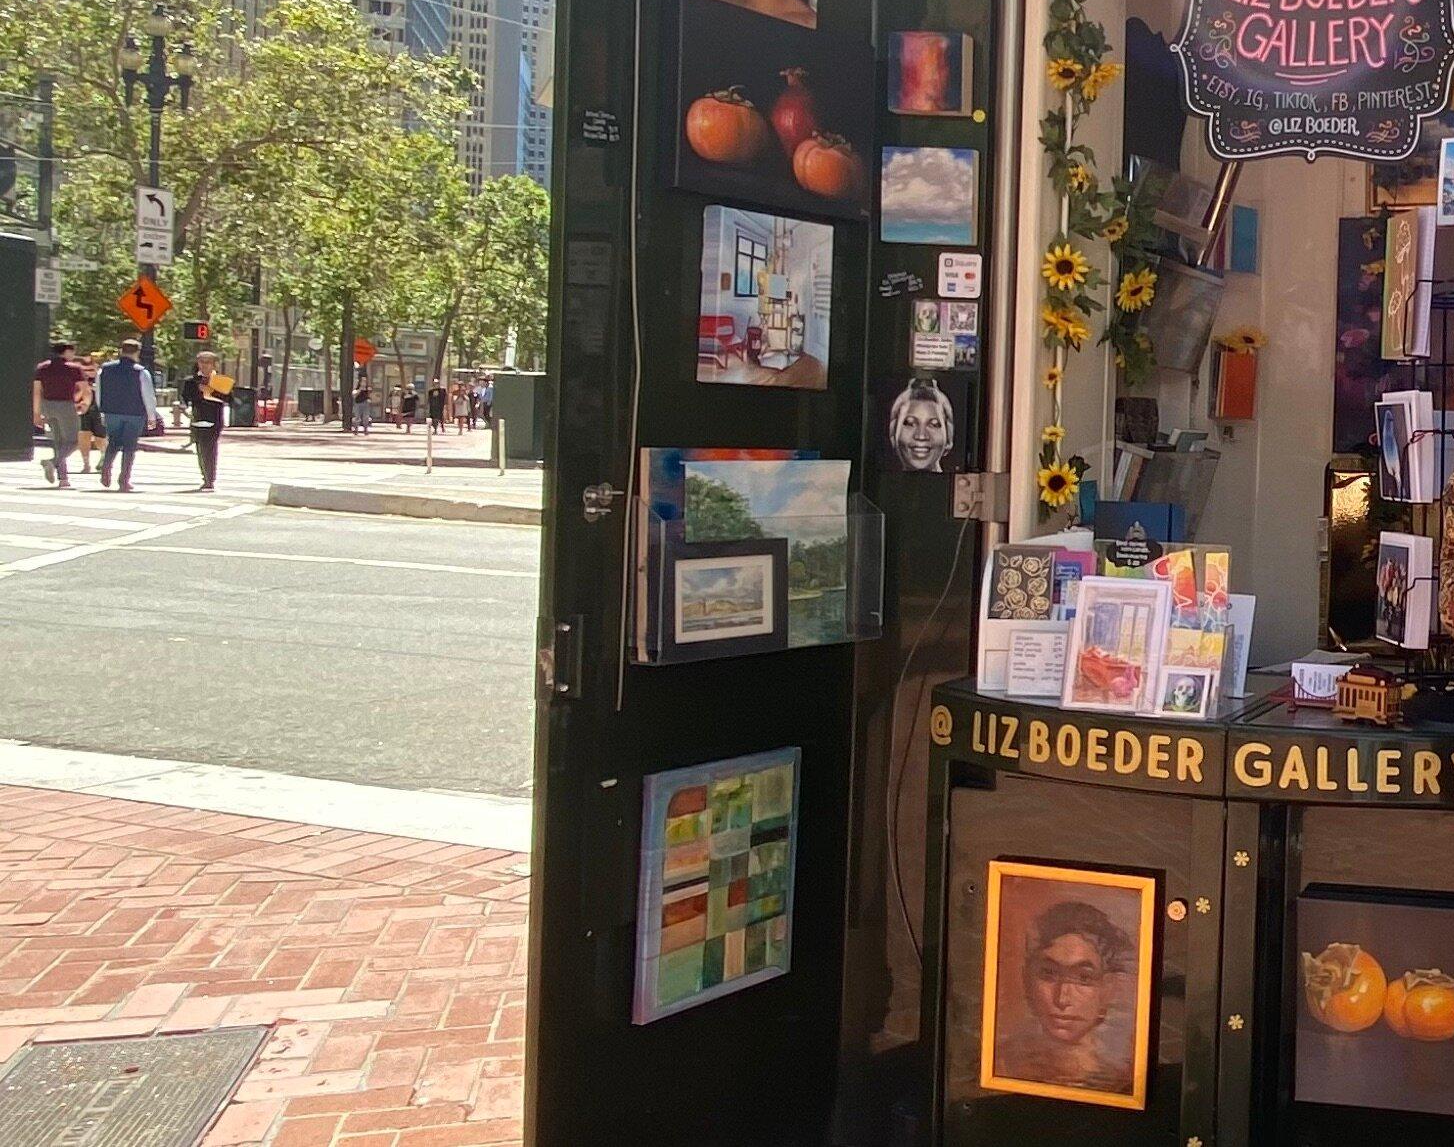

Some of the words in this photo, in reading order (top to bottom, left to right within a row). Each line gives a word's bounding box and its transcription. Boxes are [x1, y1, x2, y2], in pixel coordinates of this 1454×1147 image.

[1235, 12, 1394, 69] GALLERY
[1358, 81, 1432, 111] PINTEREST
[1269, 117, 1302, 135] @LIZ
[1305, 115, 1361, 137] BOEDER
[143, 216, 168, 227] ONLY
[929, 704, 954, 747] @
